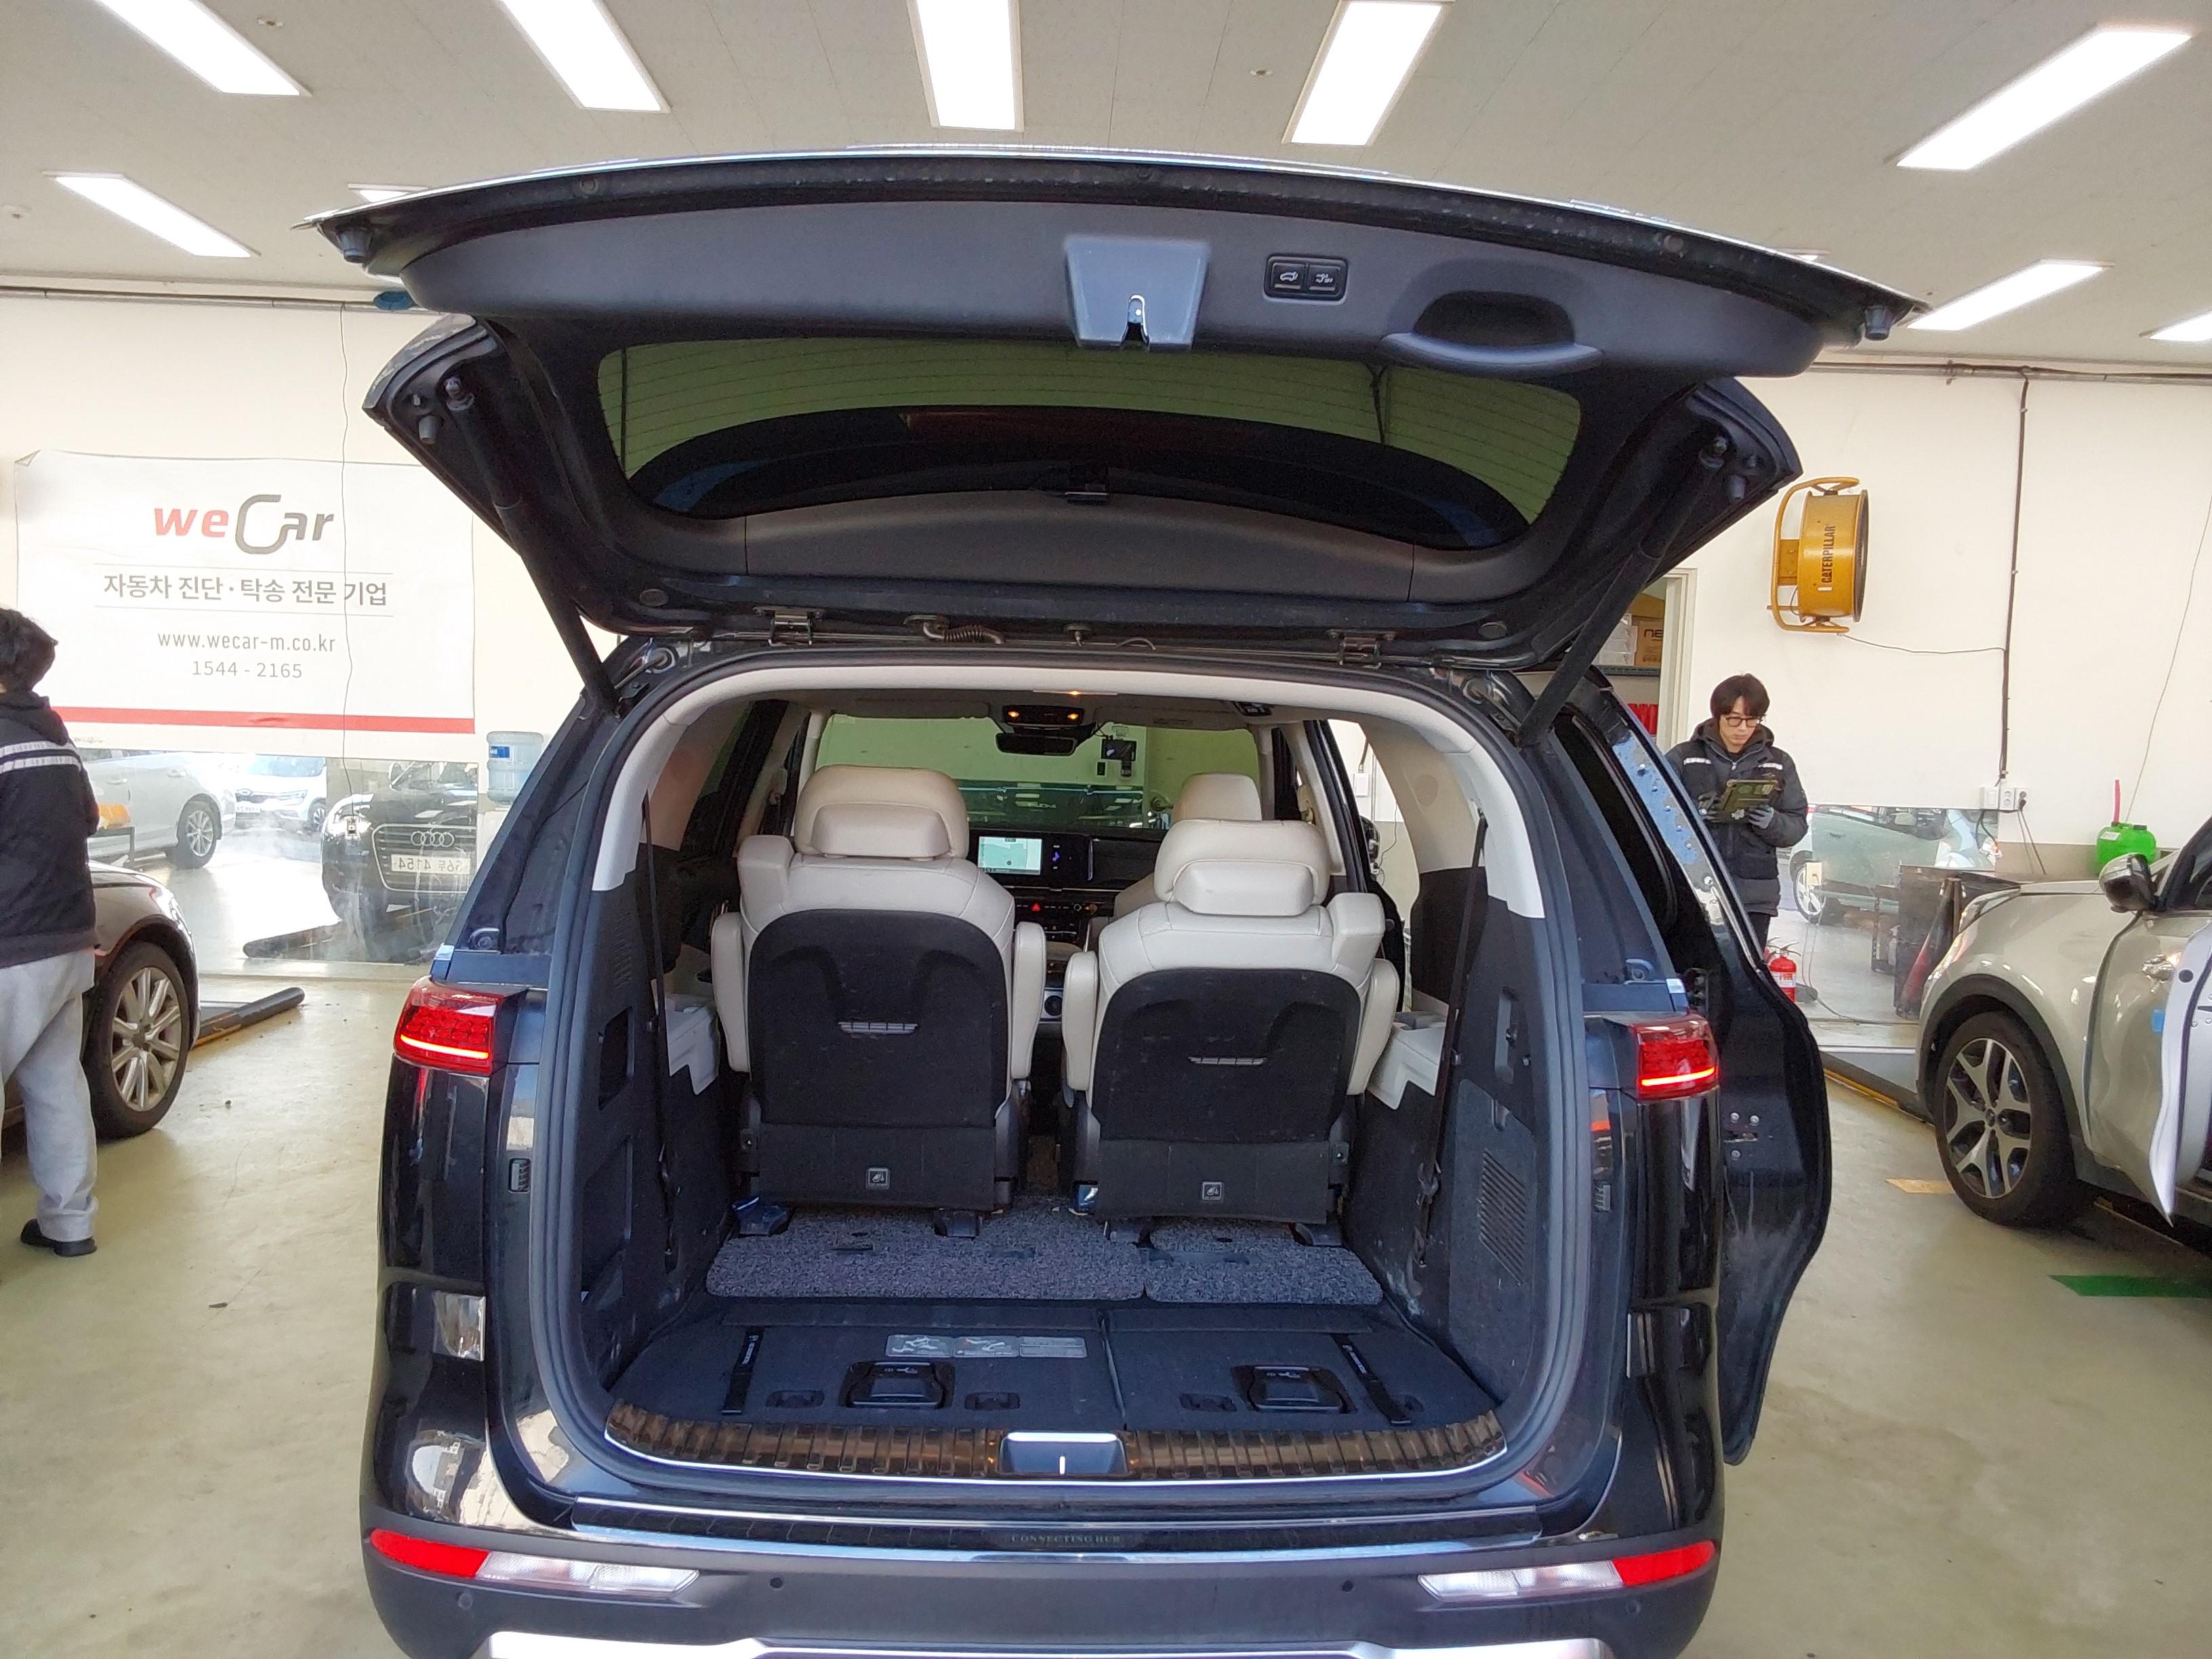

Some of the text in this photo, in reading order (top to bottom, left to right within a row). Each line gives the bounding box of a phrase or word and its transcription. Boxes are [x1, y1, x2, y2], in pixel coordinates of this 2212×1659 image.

[1821, 525, 1837, 583] CATERPILLAR
[104, 573, 172, 599] 자동차
[291, 579, 337, 605] 전문
[344, 581, 386, 607] 기업
[157, 634, 336, 652] www.wecar-m.co.kr
[1011, 1534, 1092, 1543] CONNECTING
